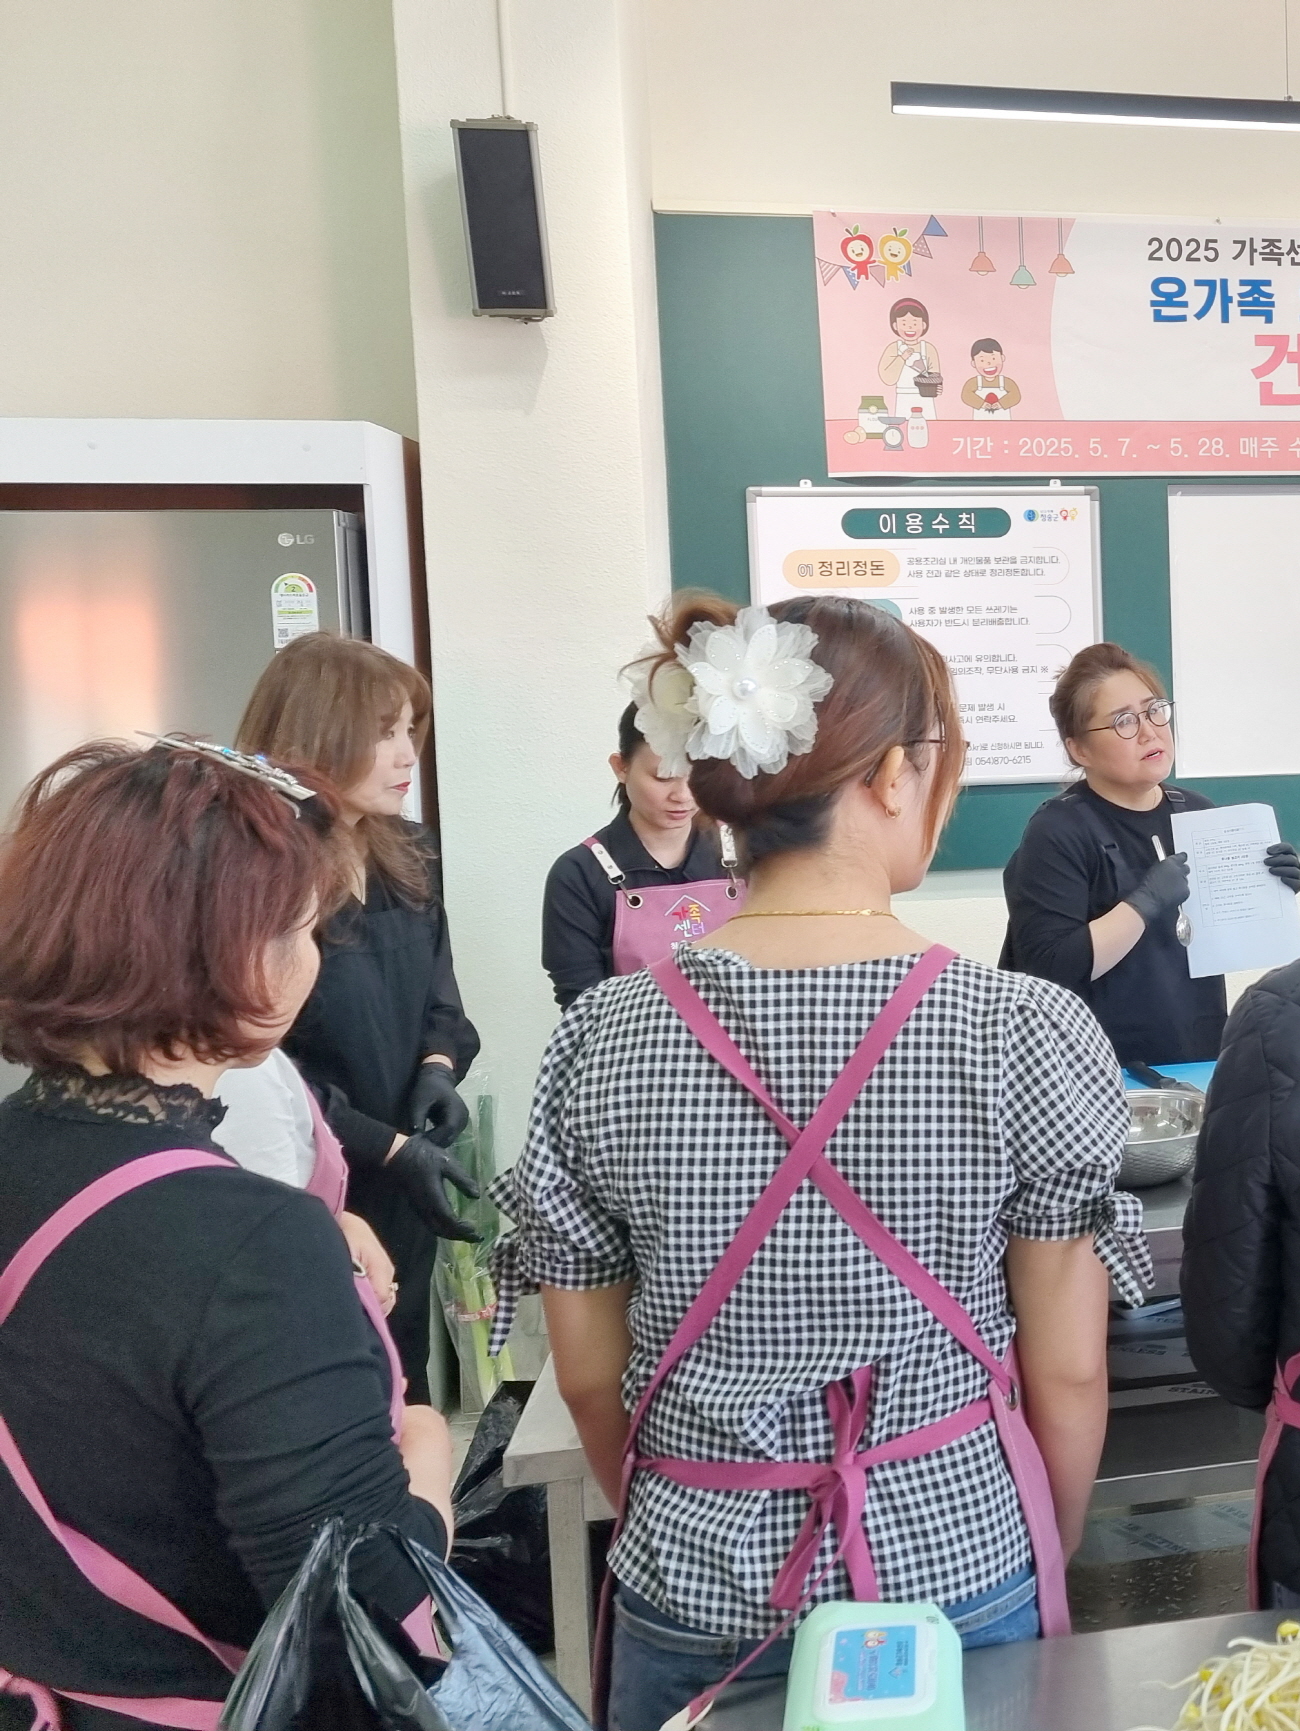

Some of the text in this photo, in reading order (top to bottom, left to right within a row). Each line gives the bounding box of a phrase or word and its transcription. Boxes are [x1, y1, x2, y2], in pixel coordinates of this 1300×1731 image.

[1147, 237, 1219, 263] 2025
[1149, 276, 1275, 325] 온가족
[952, 436, 993, 459] 기간
[1019, 438, 1080, 458] 2025.
[1089, 438, 1109, 458] 5.
[1119, 438, 1137, 458] 7.
[1170, 438, 1188, 458] 5.
[1198, 438, 1230, 458] 28.
[1240, 436, 1279, 459] 매주
[296, 534, 315, 545] LG
[949, 557, 957, 565] 내
[994, 556, 1017, 564] 보관을
[1020, 555, 1061, 565] 금지합니다.
[797, 563, 813, 577] 01
[817, 559, 886, 577] 정리정돈
[907, 570, 923, 578] 사용
[926, 570, 942, 578] 전과
[963, 569, 987, 577] 상태로
[989, 568, 1045, 577] 정리정돈합니다.
[909, 605, 1018, 615] 사용 중 발생한 모든 쓰레기는
[910, 618, 942, 627] 사용자가
[945, 618, 969, 627] 반드시
[975, 654, 1017, 662] 유의합니다.
[987, 666, 1018, 674] 무단사용
[978, 703, 994, 711] 발생
[997, 703, 1005, 711] 시
[975, 715, 1018, 723] 연락주세요.
[1024, 741, 1044, 749] 됩니다.
[975, 755, 1031, 765] 054)870-6215
[672, 904, 701, 923] 가족
[674, 920, 705, 937] 센터
